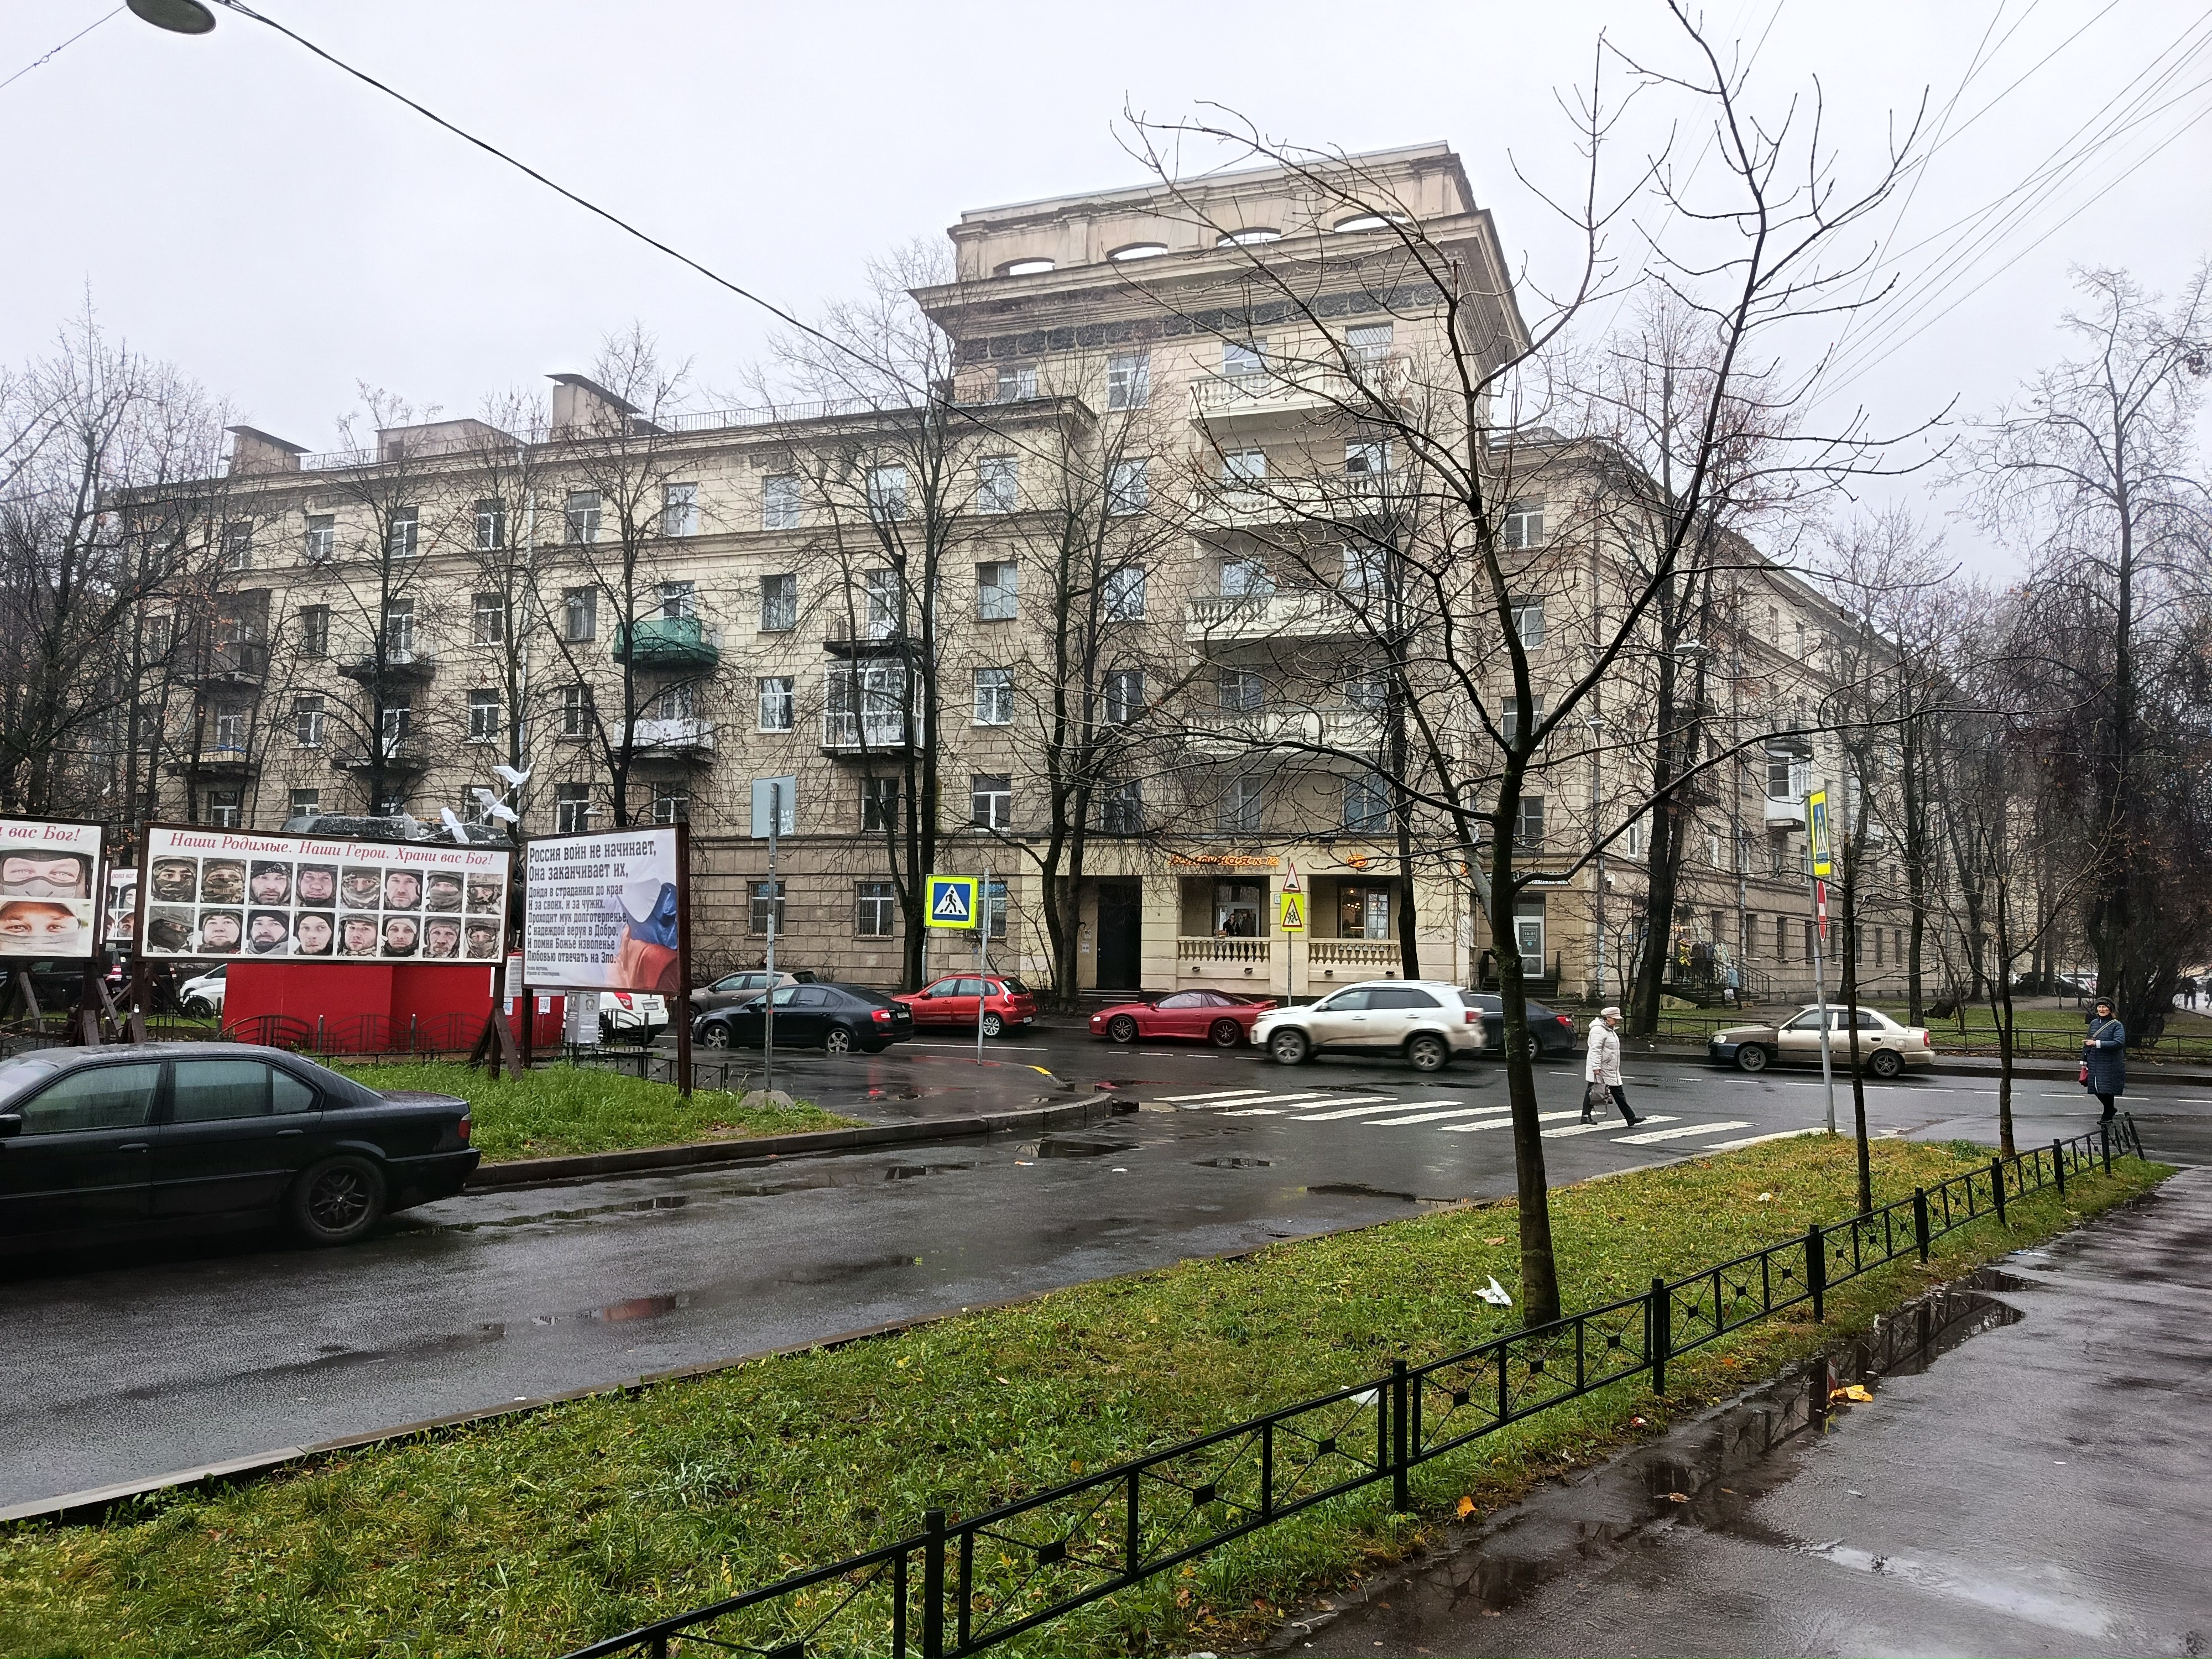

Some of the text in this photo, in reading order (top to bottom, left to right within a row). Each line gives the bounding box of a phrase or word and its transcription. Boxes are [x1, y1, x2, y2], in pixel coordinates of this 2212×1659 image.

[8, 827, 37, 838] вас
[42, 826, 81, 841] Бог!
[169, 832, 493, 865] Наши Родимые. Наши Герои. Храни вас Бог!
[529, 841, 656, 863] Россия войн не начинает,
[529, 863, 628, 881] Она заканчивает их,
[529, 885, 623, 899] Дойдя в страданиях до края
[528, 899, 605, 911] И за своих, и за чужих.
[528, 912, 629, 926] Проходит мук долготерпенье,
[528, 924, 618, 938] С надеждой веруя в Добро,
[527, 937, 615, 950] И помня Божье изволенье
[526, 950, 616, 963] Любовью отвечать на Зло.
